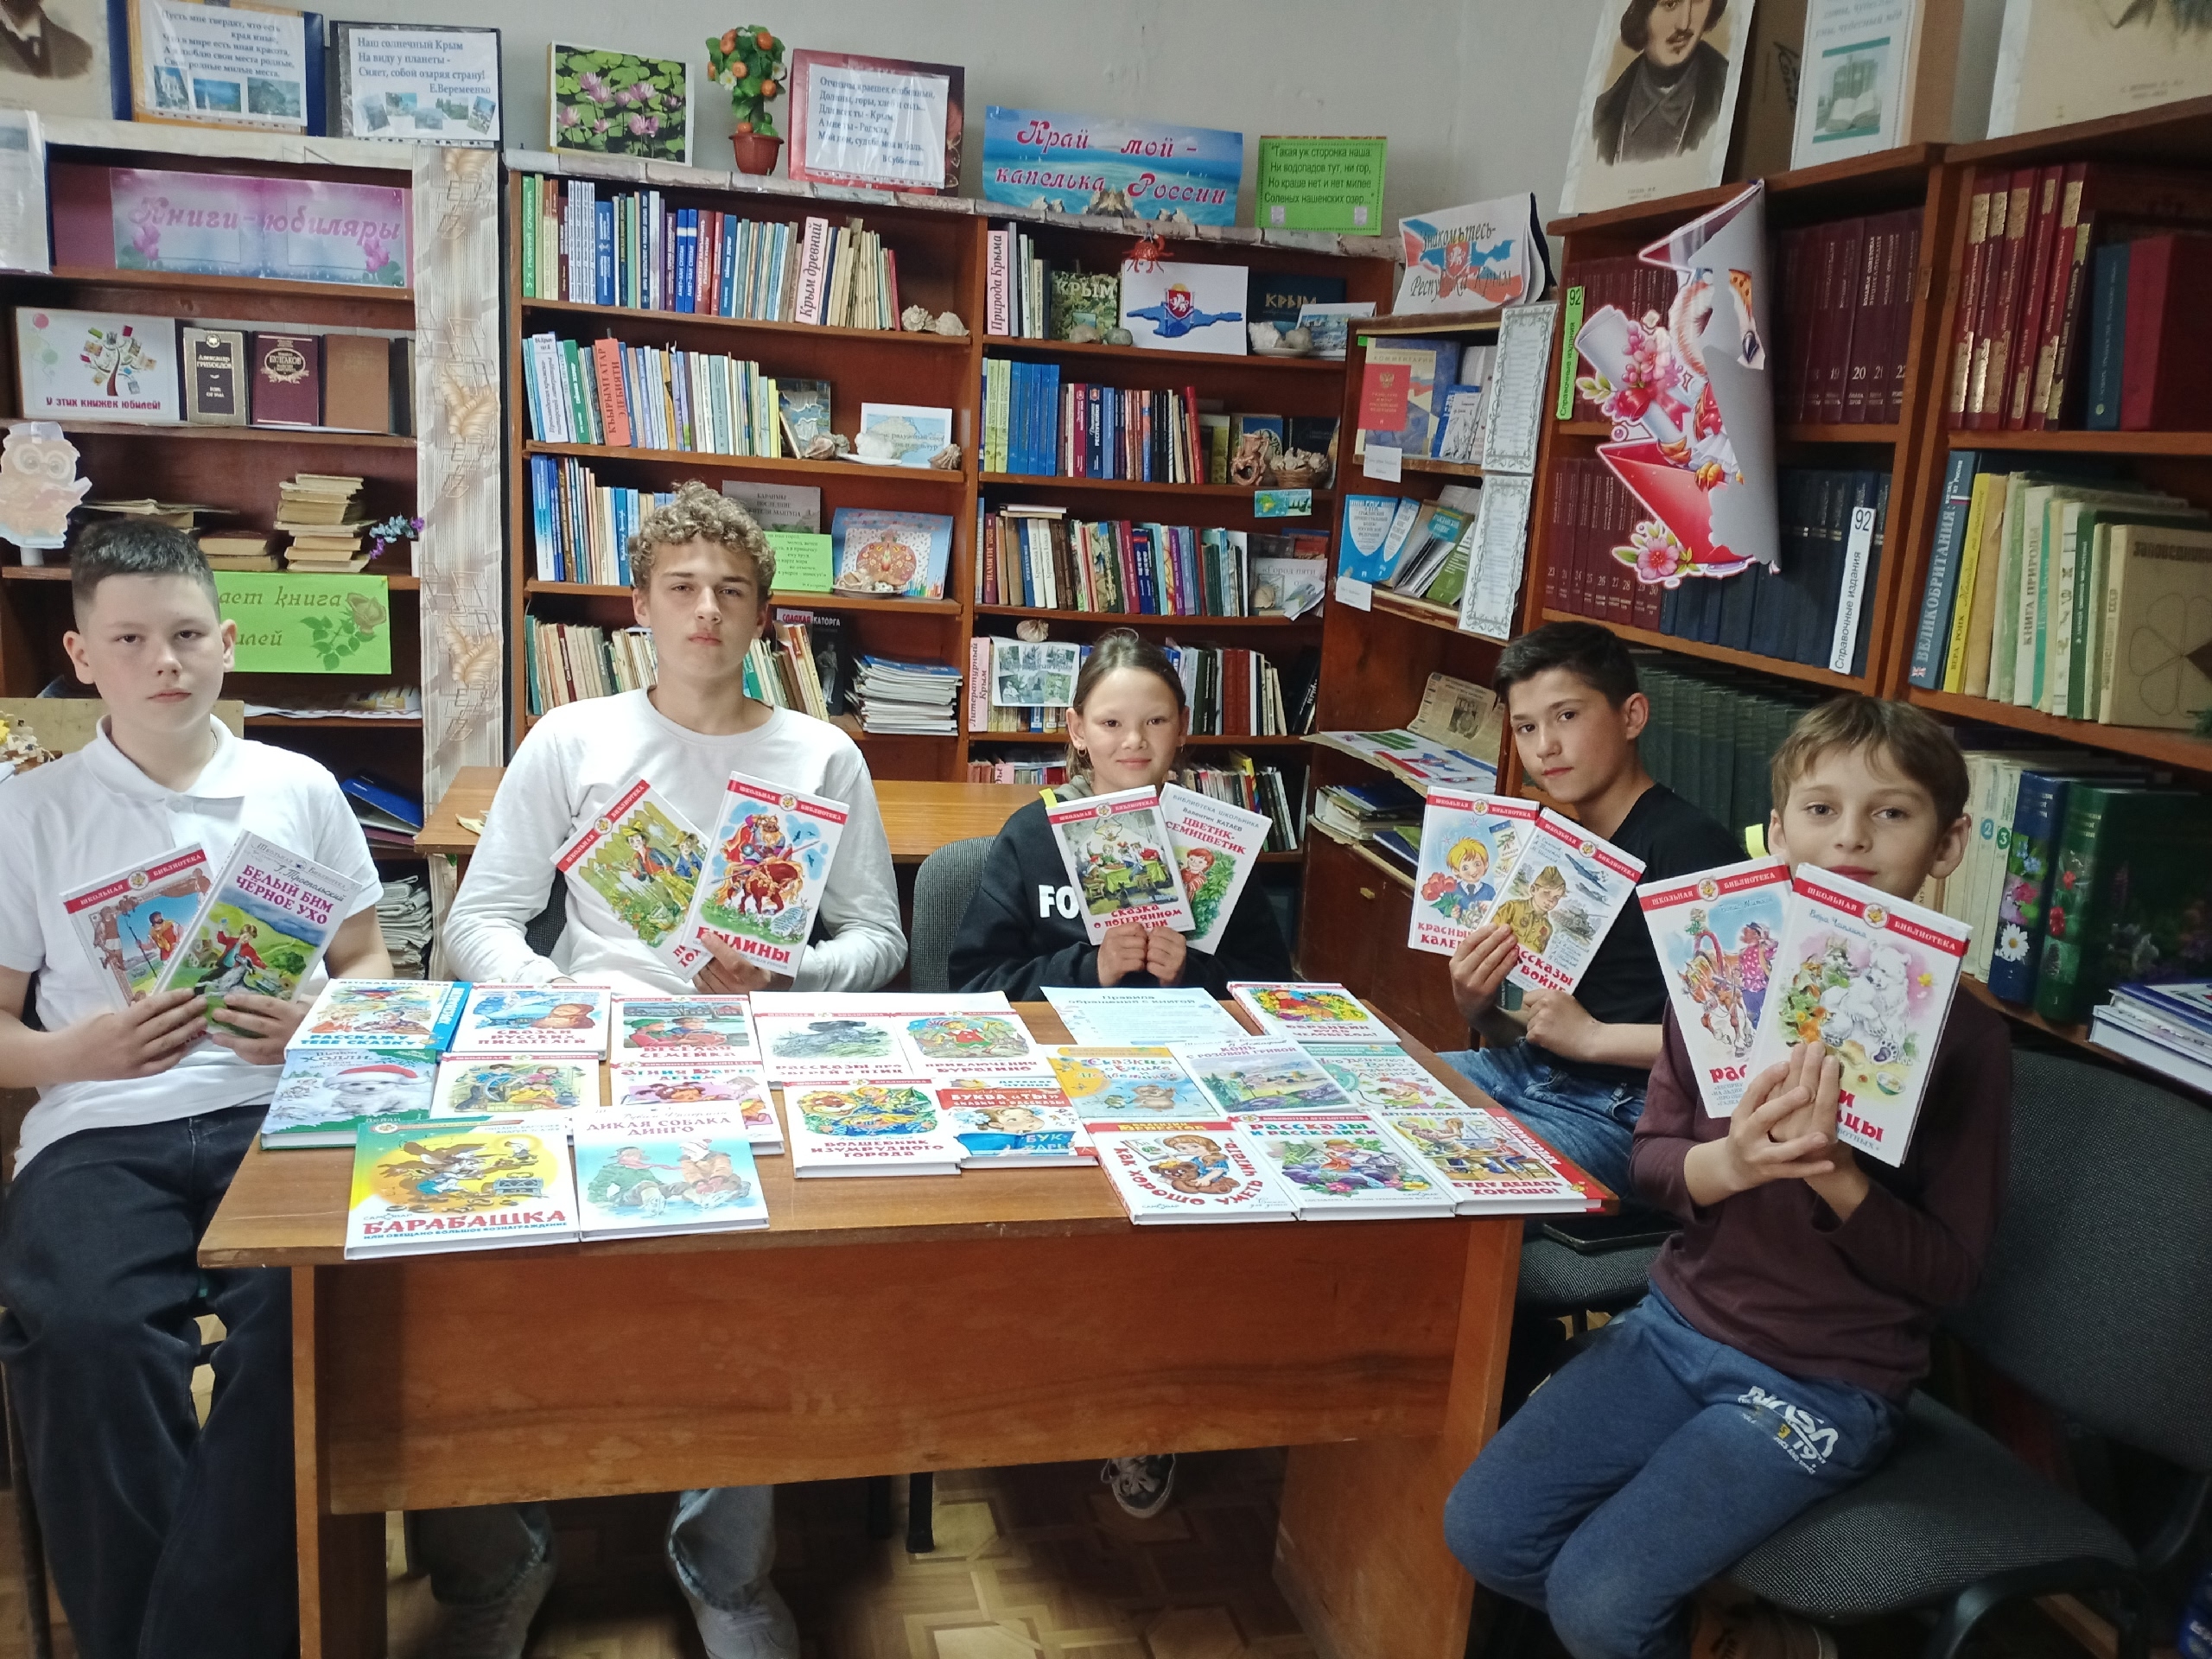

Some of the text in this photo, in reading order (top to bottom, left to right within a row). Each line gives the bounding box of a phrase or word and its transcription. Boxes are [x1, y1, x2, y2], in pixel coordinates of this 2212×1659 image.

[358, 37, 463, 52] Наш солнечный Крым
[234, 54, 258, 63] места
[359, 53, 371, 62] На
[373, 54, 395, 65] виду
[359, 67, 486, 84] Сияет, собой озаряя страну!
[1017, 120, 1173, 157] Край мой
[1299, 148, 1346, 159] уж сторонка
[1270, 162, 1281, 172] Ни
[1283, 163, 1325, 174] водопадов
[1356, 164, 1371, 175] гор,
[995, 167, 1227, 204] капелька России
[1268, 177, 1371, 189] Но краше нет нет милее
[1264, 192, 1344, 204] Соленых нашенских
[800, 222, 822, 318] Крым древний
[990, 235, 1005, 331] Природа Крыма
[1056, 281, 1117, 299] КРЫМ
[1570, 289, 1583, 306] 92
[1559, 321, 1576, 417] Справочные издания
[1853, 366, 1866, 379] 20
[598, 348, 616, 434] КЪЫРЫМТАТАР
[56, 397, 161, 411] этих книжек юбилей!
[1855, 509, 1872, 532] 92
[276, 586, 341, 608] книга
[813, 616, 841, 626] КАТОРГА
[1834, 551, 1861, 670] Справочные издания
[2023, 602, 2036, 646] КНИГА
[969, 643, 978, 727] Литературный
[979, 671, 988, 701] Крым
[740, 785, 842, 822] ШКОЛЬНАЯ БИБЛИОТЕКА
[1059, 799, 1154, 822] ШКОЛЬНАЯ БИБЛИОТЕКА
[1173, 794, 1260, 829] БИБЛИОТЕКА ШКОЛЬНИКА
[1435, 798, 1531, 818] ШКОЛЬНАЯ БИБЛИОТЕКА
[564, 785, 645, 864] ШКОЛЬНАЯ БИБЛИОТЕКА
[1182, 817, 1236, 841] ЦВЕТИК-
[1217, 818, 1243, 832] КАТАЕВ
[1984, 822, 1993, 836] 2
[1166, 822, 1246, 855] СЕМИЦВЕТИК
[1999, 832, 2008, 845] 3
[1545, 822, 1636, 879] ШКОЛЬНАЯ БИБЛИОТЕКА
[79, 854, 202, 906] ШКОЛЬНАЯ БИБЛИОТЕКА
[242, 864, 334, 914] БЕЛЫЙ БИМ
[1652, 871, 1777, 906] ШКОЛЬНАЯ БИБЛИОТЕКА
[296, 902, 328, 925] УХО
[1808, 887, 1956, 951] ШКОЛЬНАЯ БИБЛИОТЕКА
[587, 1117, 732, 1131] ДИКАЯ СОБАКА
[627, 1126, 695, 1136] ДИНГО
[1114, 1147, 1263, 1205] КАК ХОРОШО УМЕТЬ
[364, 1211, 566, 1235] БАРАБАШКА
[483, 1222, 568, 1231] ВОЗНАГРАЖДЕНИЕ
